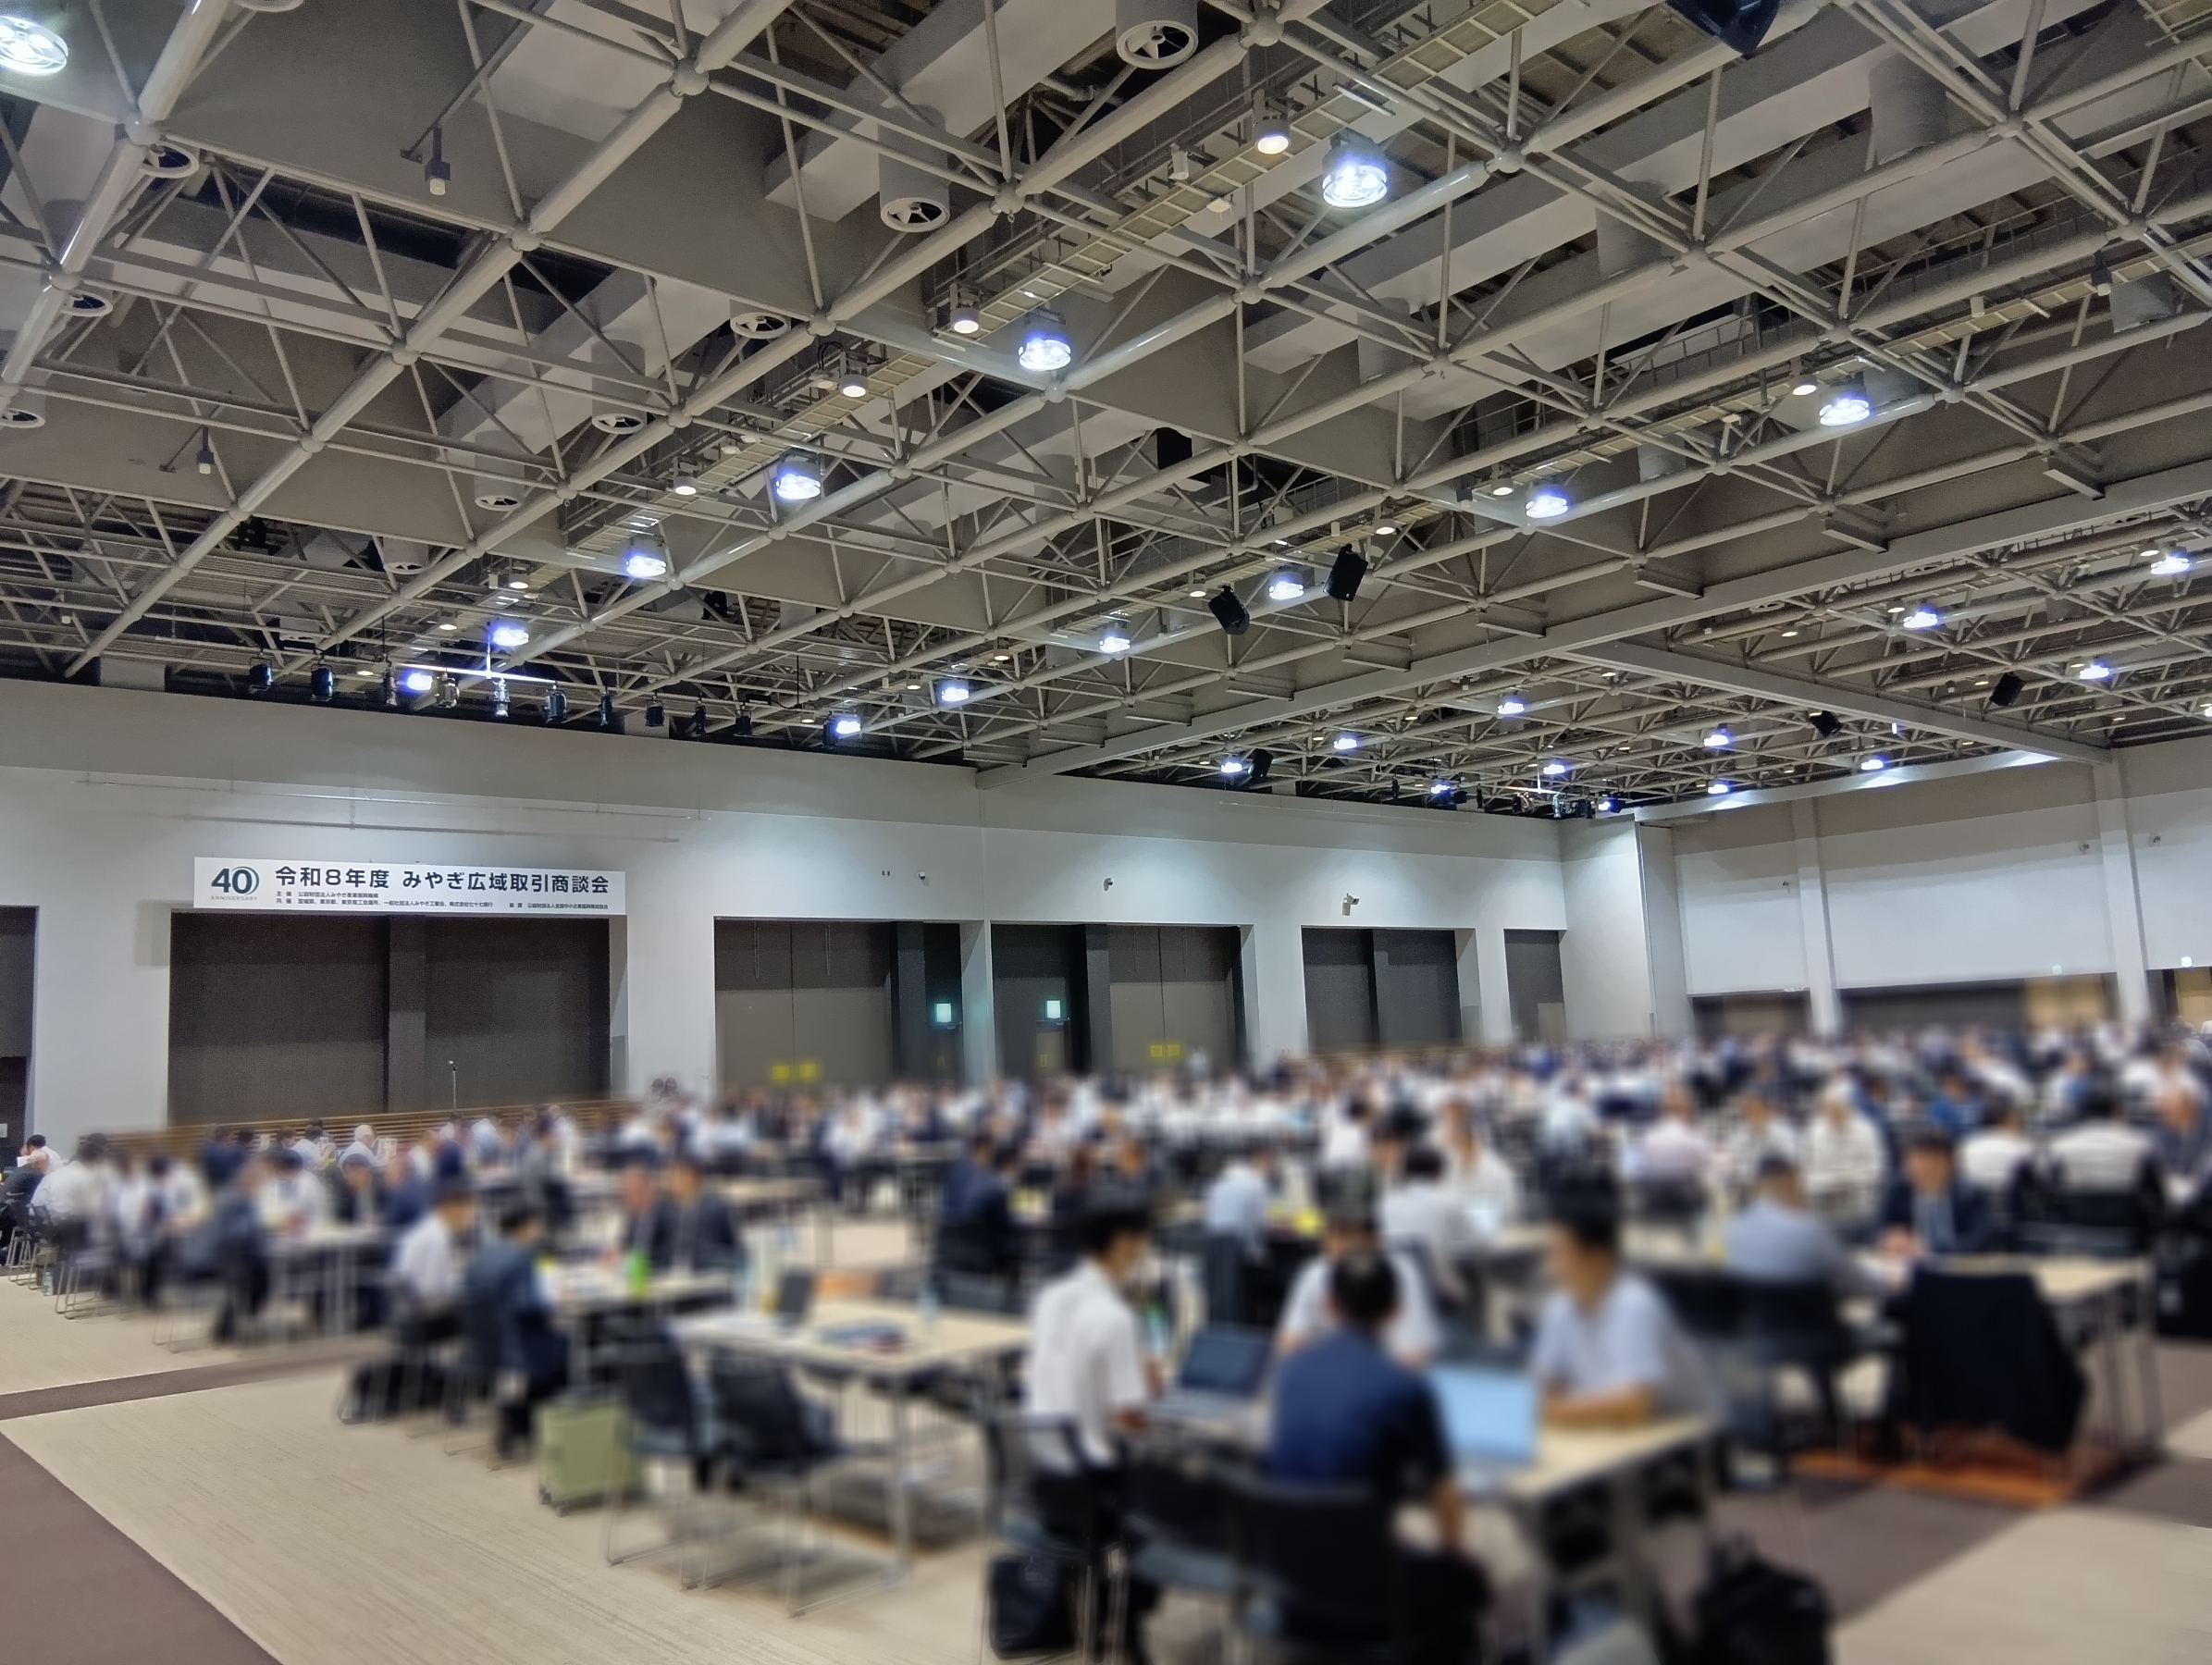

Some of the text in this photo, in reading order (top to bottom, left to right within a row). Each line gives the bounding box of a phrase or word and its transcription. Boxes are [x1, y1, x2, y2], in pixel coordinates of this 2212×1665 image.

[211, 868, 253, 894] 40
[276, 866, 609, 893] 令和8年度 みやぎ広域取引商談会
